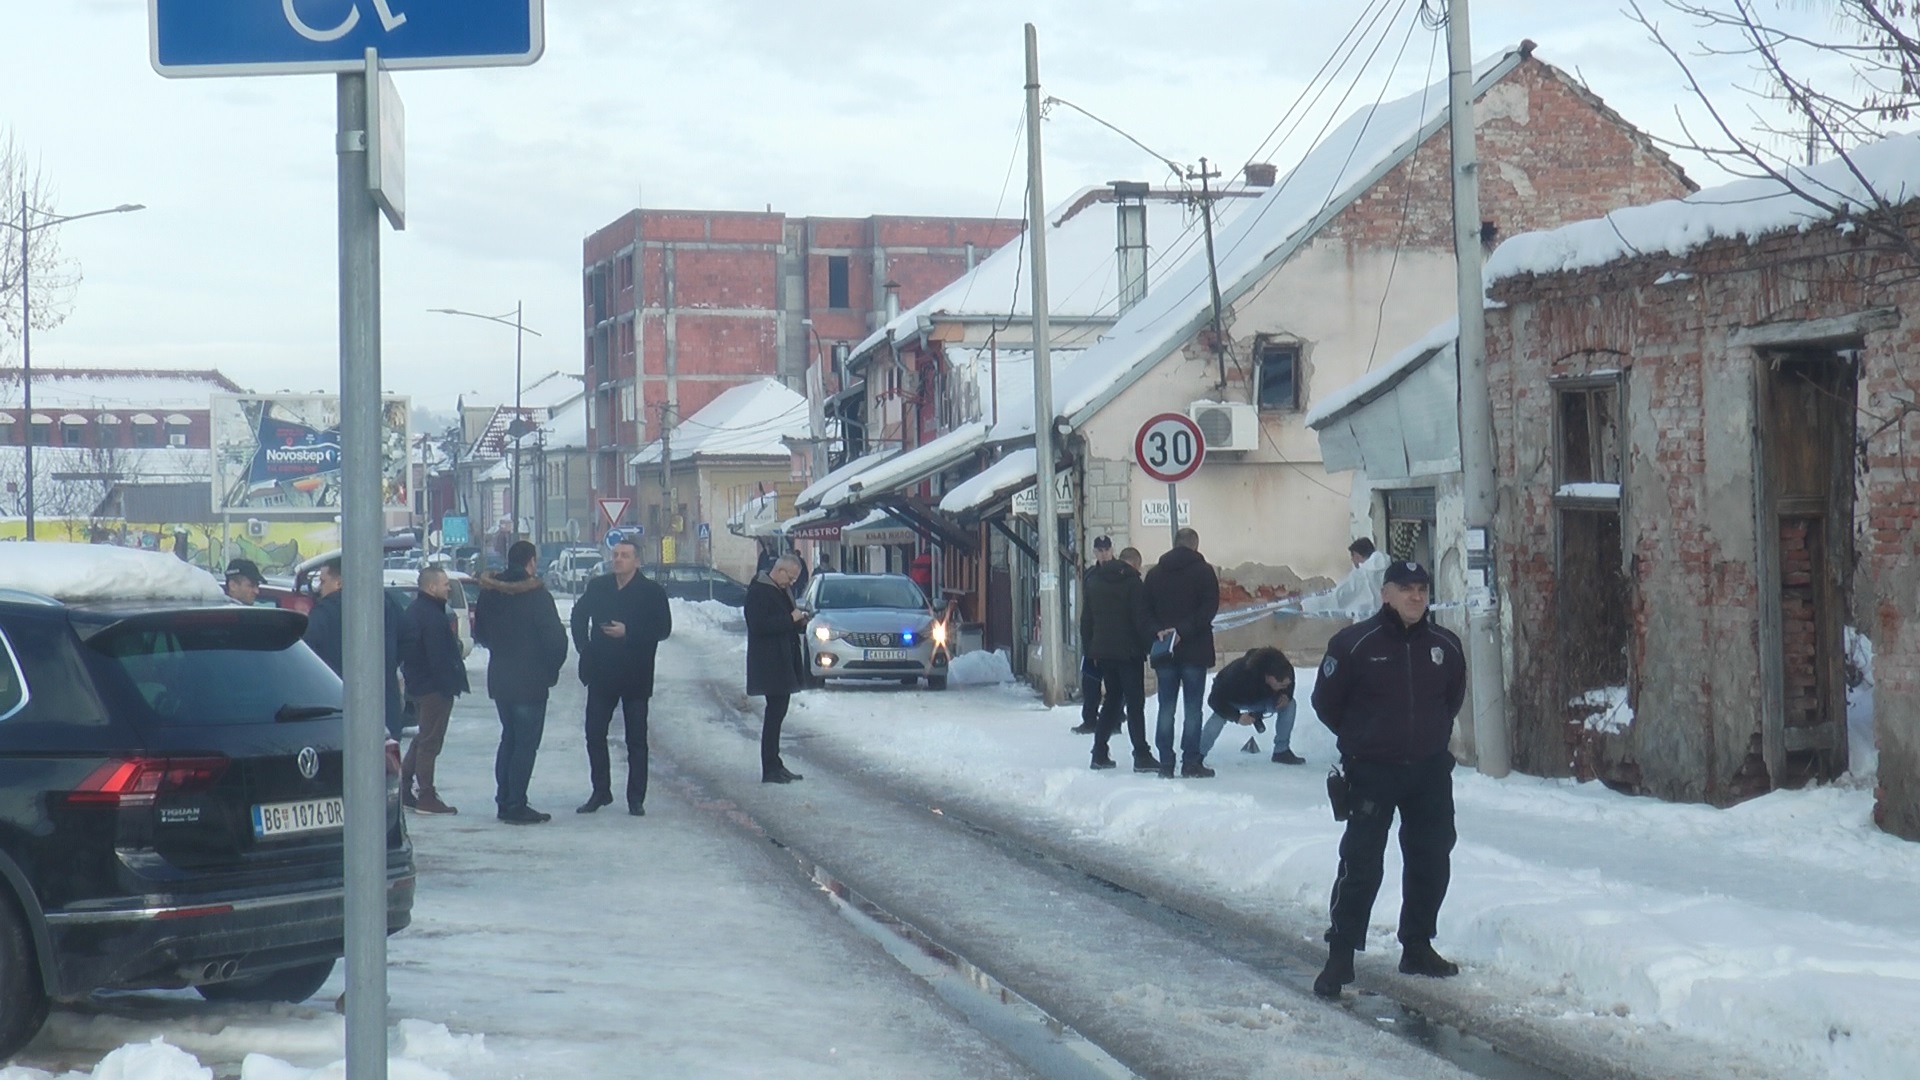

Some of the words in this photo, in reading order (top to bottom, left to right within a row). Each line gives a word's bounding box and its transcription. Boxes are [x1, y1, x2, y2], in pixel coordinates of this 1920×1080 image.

[1149, 429, 1192, 467] 30
[266, 449, 324, 464] Novostep
[1143, 502, 1189, 515] АДВОАТ
[794, 526, 839, 539] MAESTRO
[160, 807, 200, 817] TIGUAN
[264, 807, 282, 831] BG
